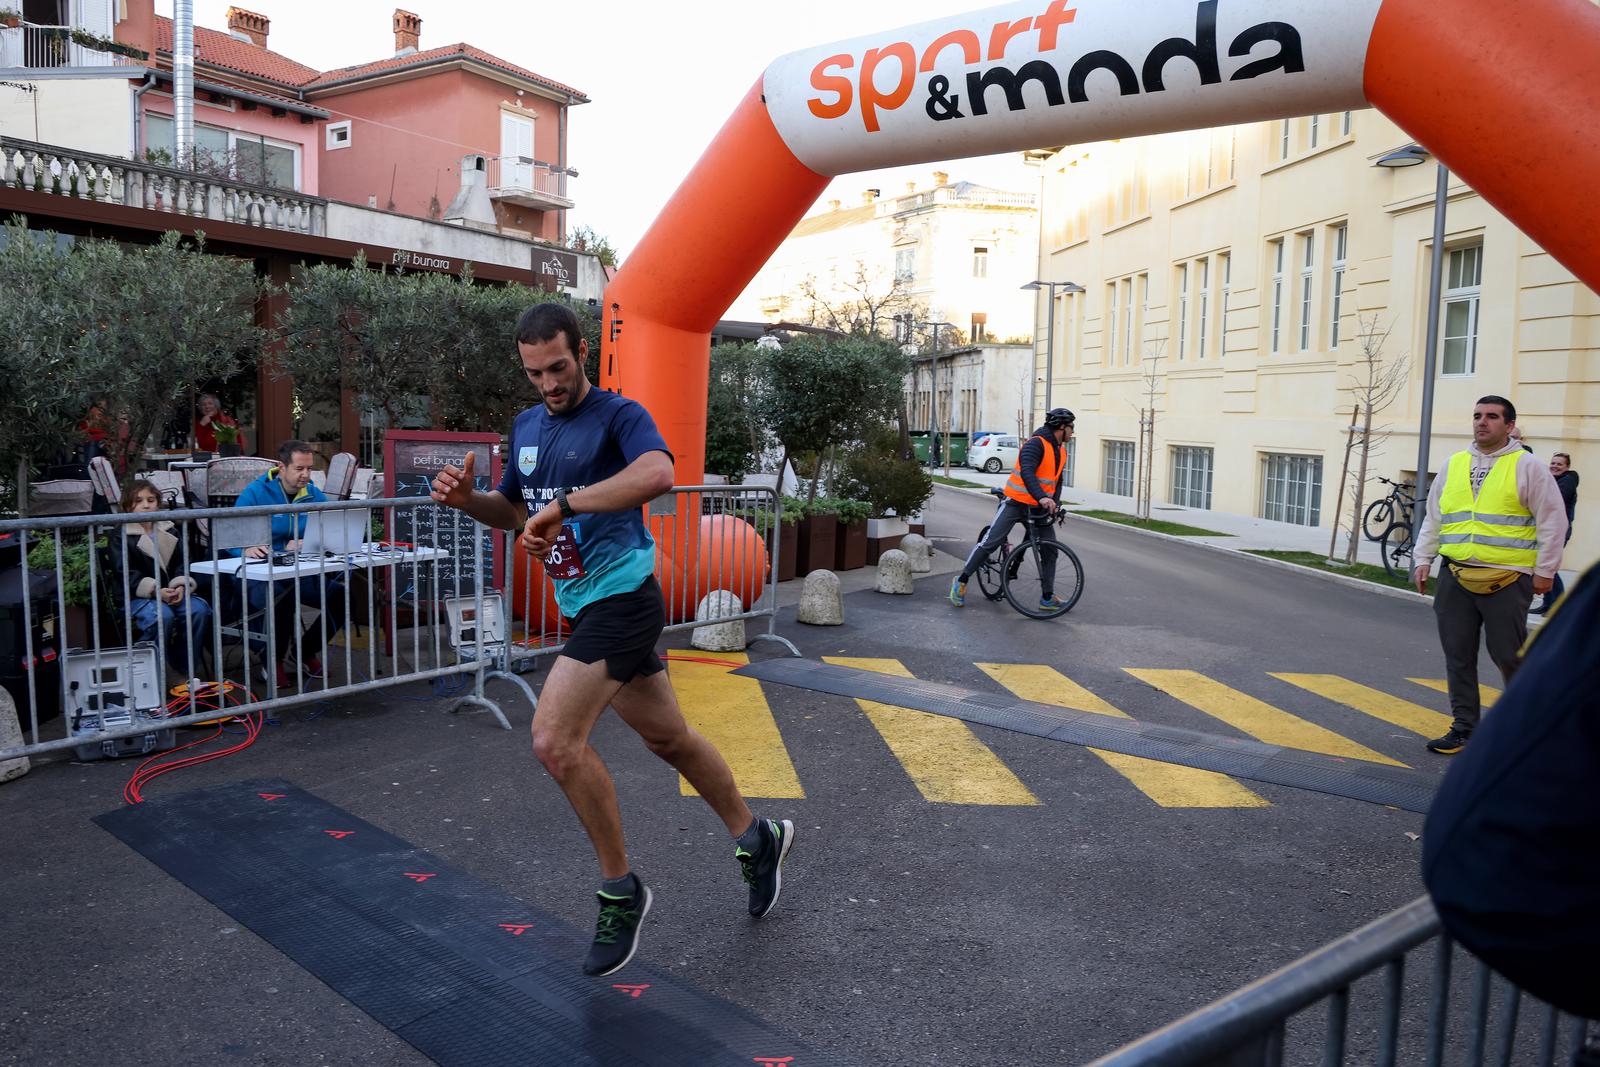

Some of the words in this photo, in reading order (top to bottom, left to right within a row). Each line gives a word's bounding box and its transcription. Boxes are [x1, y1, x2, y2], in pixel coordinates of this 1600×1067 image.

[807, 0, 1076, 132] sport
[392, 252, 410, 264] pt
[413, 252, 449, 270] bunara
[413, 456, 431, 466] pet
